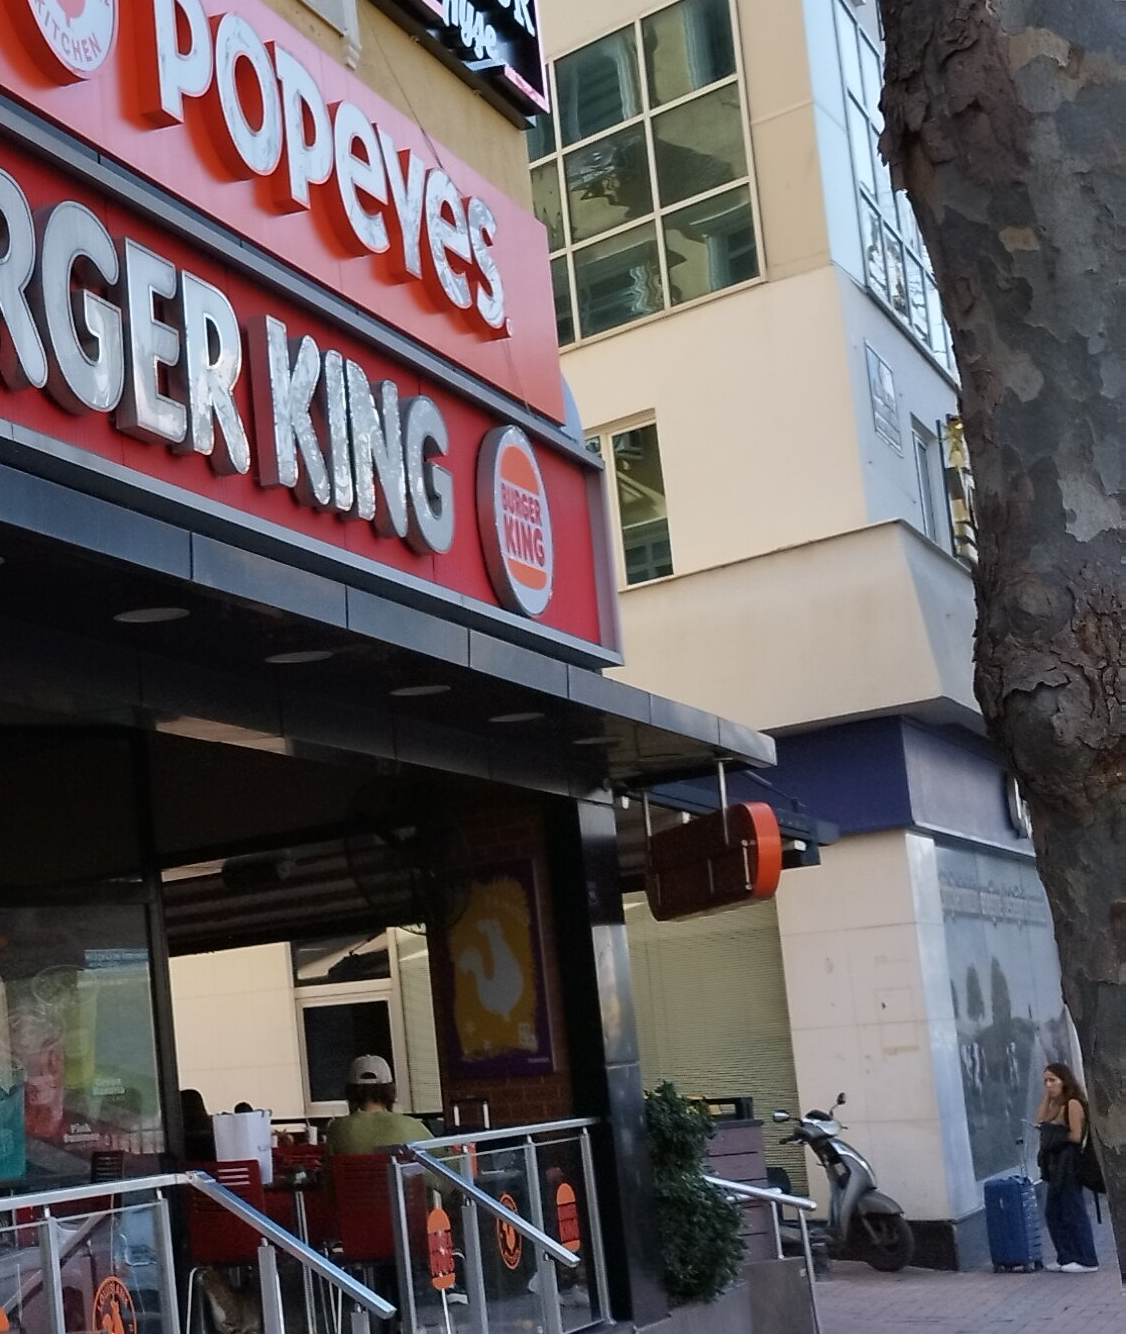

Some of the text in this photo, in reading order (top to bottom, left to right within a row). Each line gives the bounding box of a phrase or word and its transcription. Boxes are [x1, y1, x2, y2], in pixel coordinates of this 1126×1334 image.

[265, 314, 456, 554] KING
[500, 482, 543, 527] BURGER
[504, 513, 546, 568] KING
